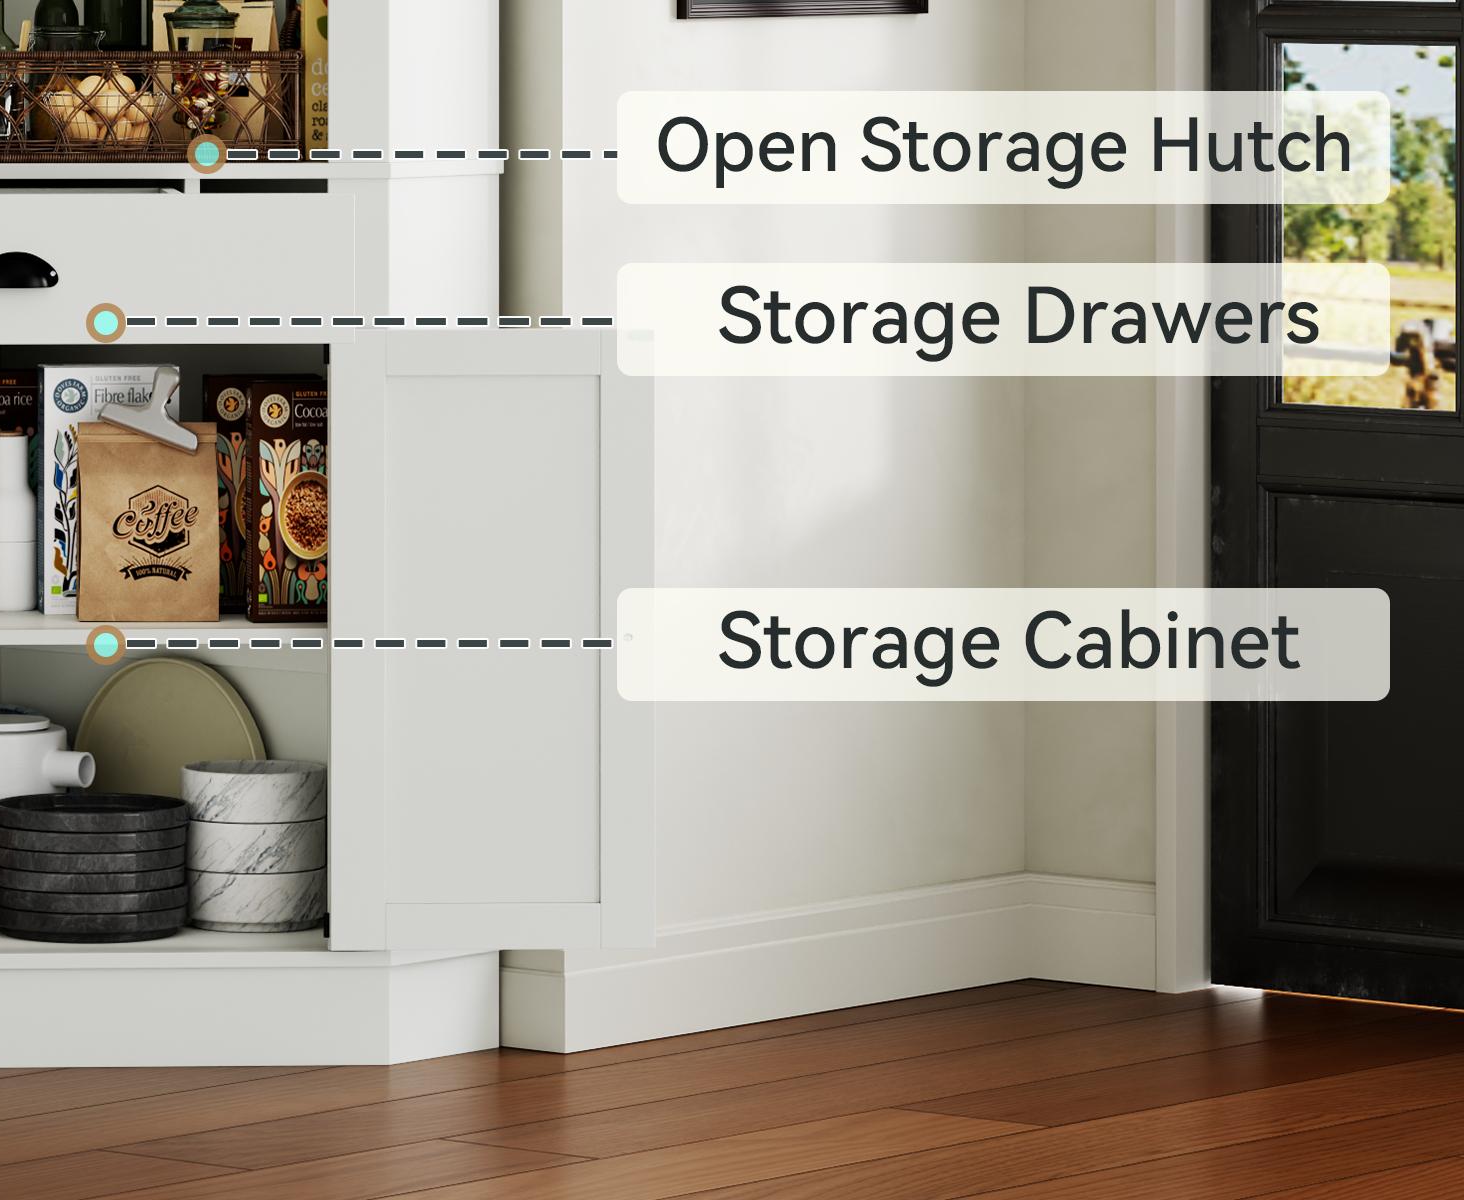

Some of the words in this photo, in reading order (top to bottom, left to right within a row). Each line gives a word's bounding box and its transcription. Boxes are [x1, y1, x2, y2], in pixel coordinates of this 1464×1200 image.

[13, 391, 33, 406] rice
[94, 387, 125, 404] Fibre
[295, 391, 318, 399] GLUTEN
[56, 399, 86, 412] ORGANIC
[294, 403, 328, 419] Cocoa
[113, 501, 198, 538] Coffee
